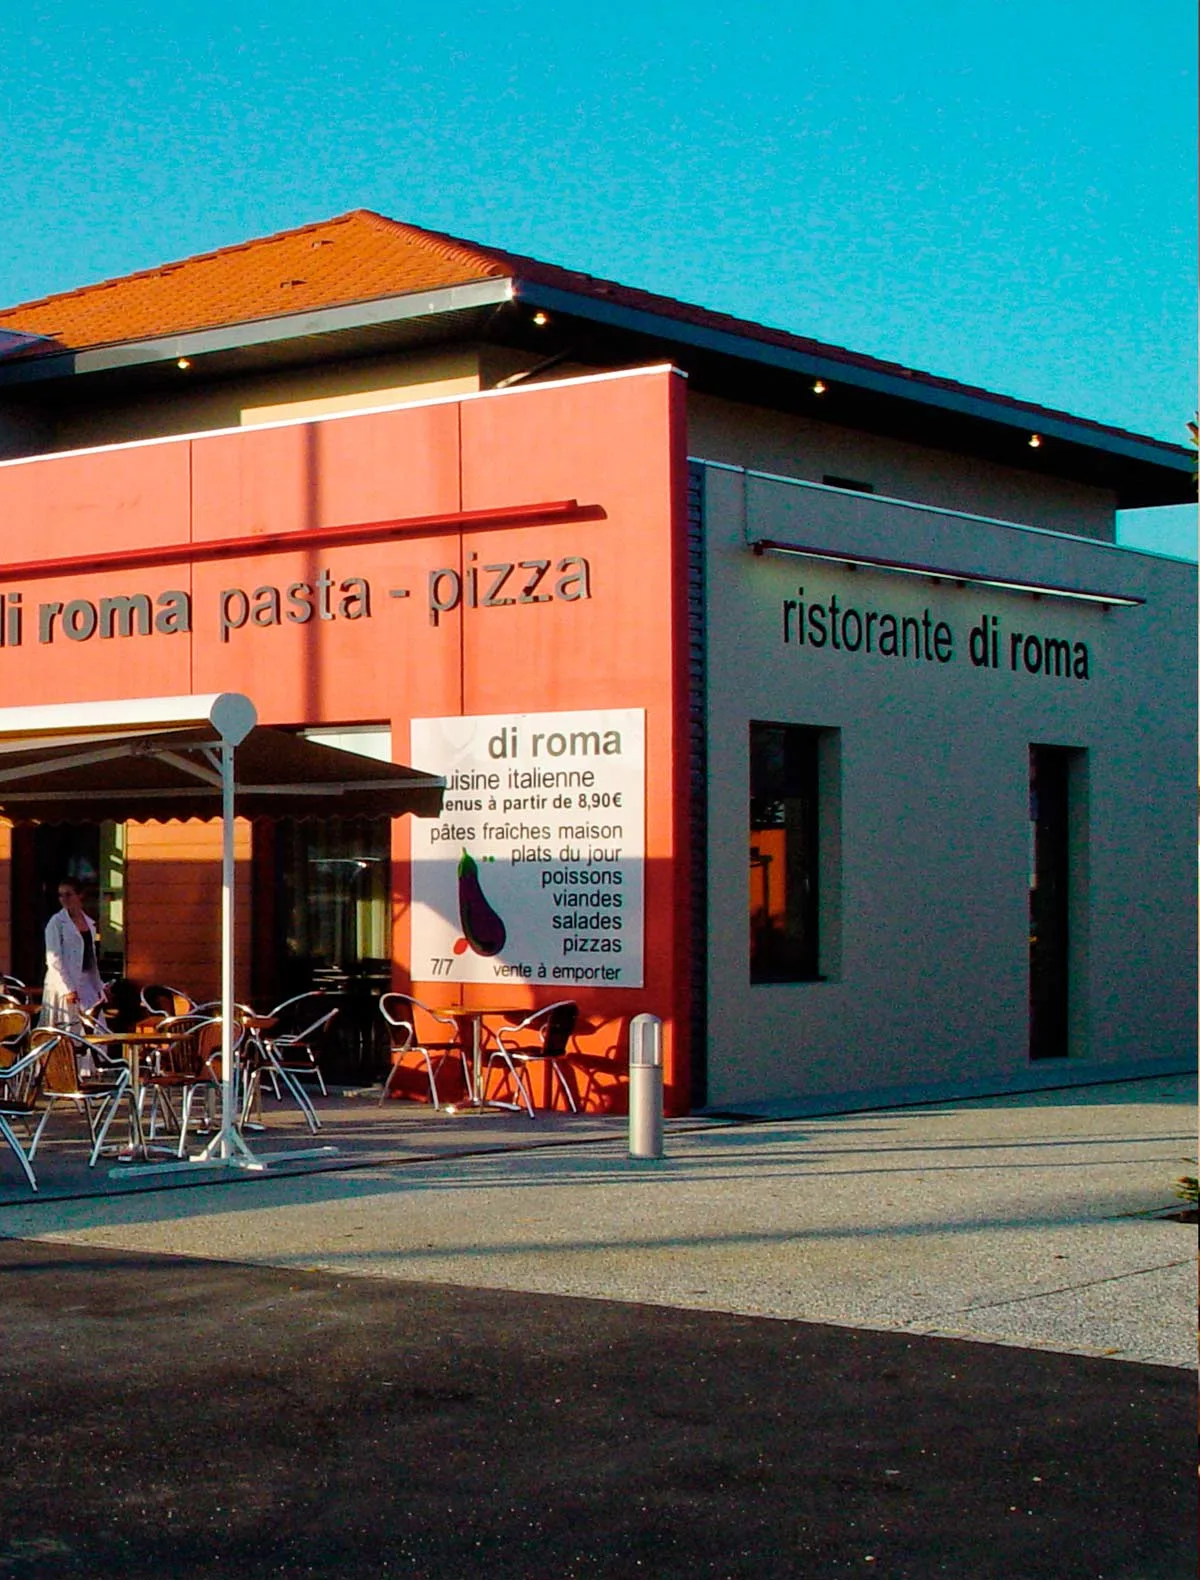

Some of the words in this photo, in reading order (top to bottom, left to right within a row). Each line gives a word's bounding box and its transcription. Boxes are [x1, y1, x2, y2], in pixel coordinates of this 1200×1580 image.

[39, 589, 193, 644] roma
[219, 567, 372, 643] pasta
[388, 589, 410, 599] -
[428, 552, 592, 626] pizza
[782, 587, 953, 663] ristorante
[969, 614, 999, 668] di
[1010, 631, 1090, 680] roma
[488, 727, 518, 759] di
[532, 730, 622, 757] roma
[446, 768, 500, 791] uisine
[508, 767, 595, 789] italienne
[445, 799, 482, 812] enus
[488, 795, 497, 810] à
[503, 795, 547, 814] partir
[553, 794, 572, 809] de
[578, 792, 622, 811] 8,90€
[430, 823, 475, 844] pâtes
[482, 822, 551, 841] fraîches
[558, 821, 623, 840] maison
[511, 845, 552, 866] plats
[559, 845, 580, 863] du
[586, 846, 622, 866] jour
[542, 867, 623, 888] poissons
[553, 890, 623, 908] viandes
[552, 912, 622, 930] salades
[563, 935, 622, 955] pizzas
[430, 958, 454, 976] 7/7
[493, 963, 532, 978] vente
[538, 963, 547, 979] à
[552, 965, 621, 981] emporter
